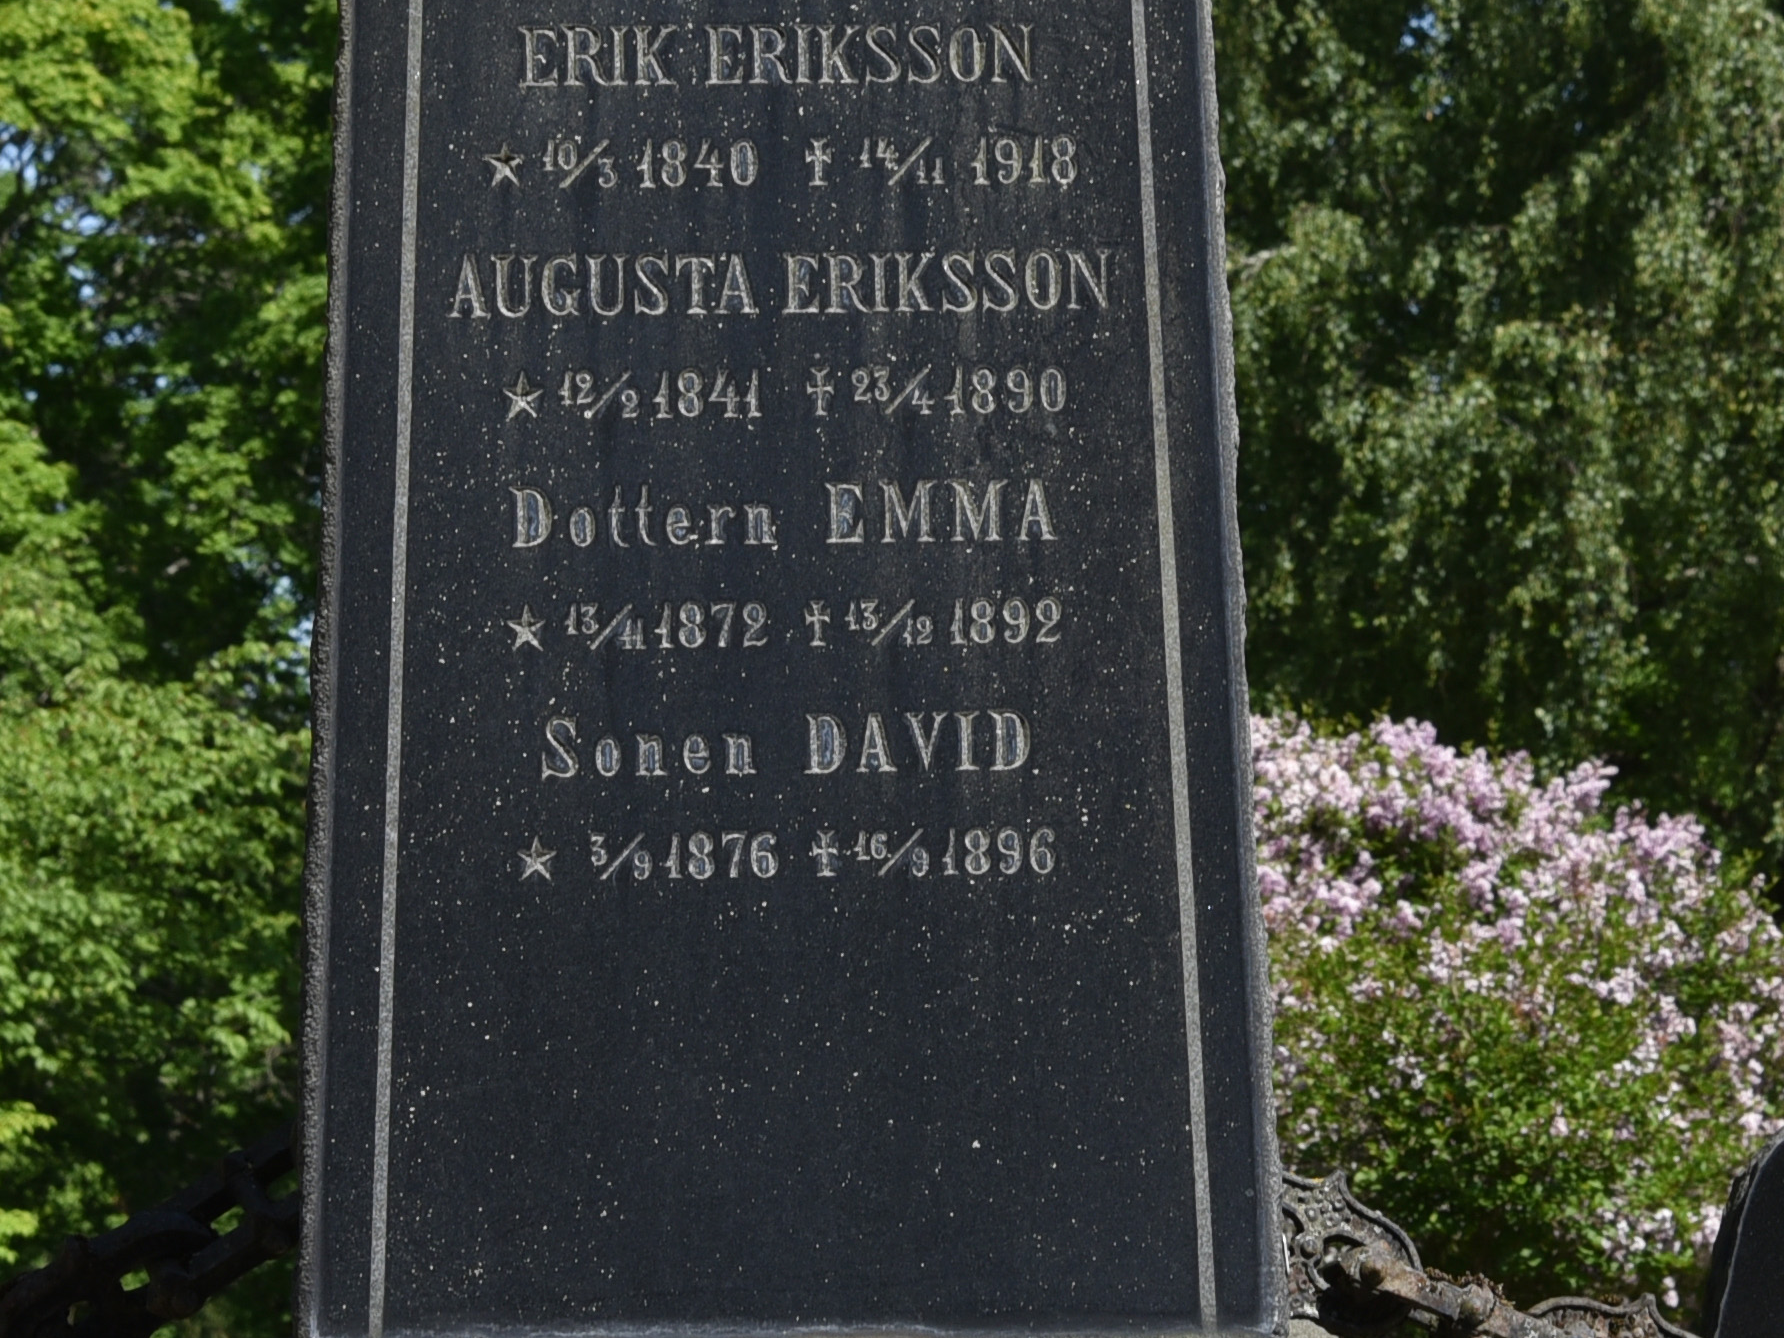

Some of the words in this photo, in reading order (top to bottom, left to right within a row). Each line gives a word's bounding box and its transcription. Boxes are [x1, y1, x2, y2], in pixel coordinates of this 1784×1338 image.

[518, 24, 677, 88] ERIK
[705, 23, 1035, 85] ERIKSSON
[638, 137, 759, 188] 1840
[971, 134, 1078, 186] 1918
[448, 253, 759, 317] AUGUSTA
[781, 248, 1112, 316] ERIKSSON
[652, 367, 763, 419] 1841
[944, 364, 1067, 415] 1890
[509, 483, 777, 549] Dottern
[824, 479, 1059, 545] EMMA
[654, 600, 769, 649] 1872
[949, 596, 1063, 645] 1892
[541, 714, 758, 779] Sonen
[804, 711, 1033, 775] DAVID
[663, 829, 780, 880] 1876
[942, 826, 1056, 875] 1896
